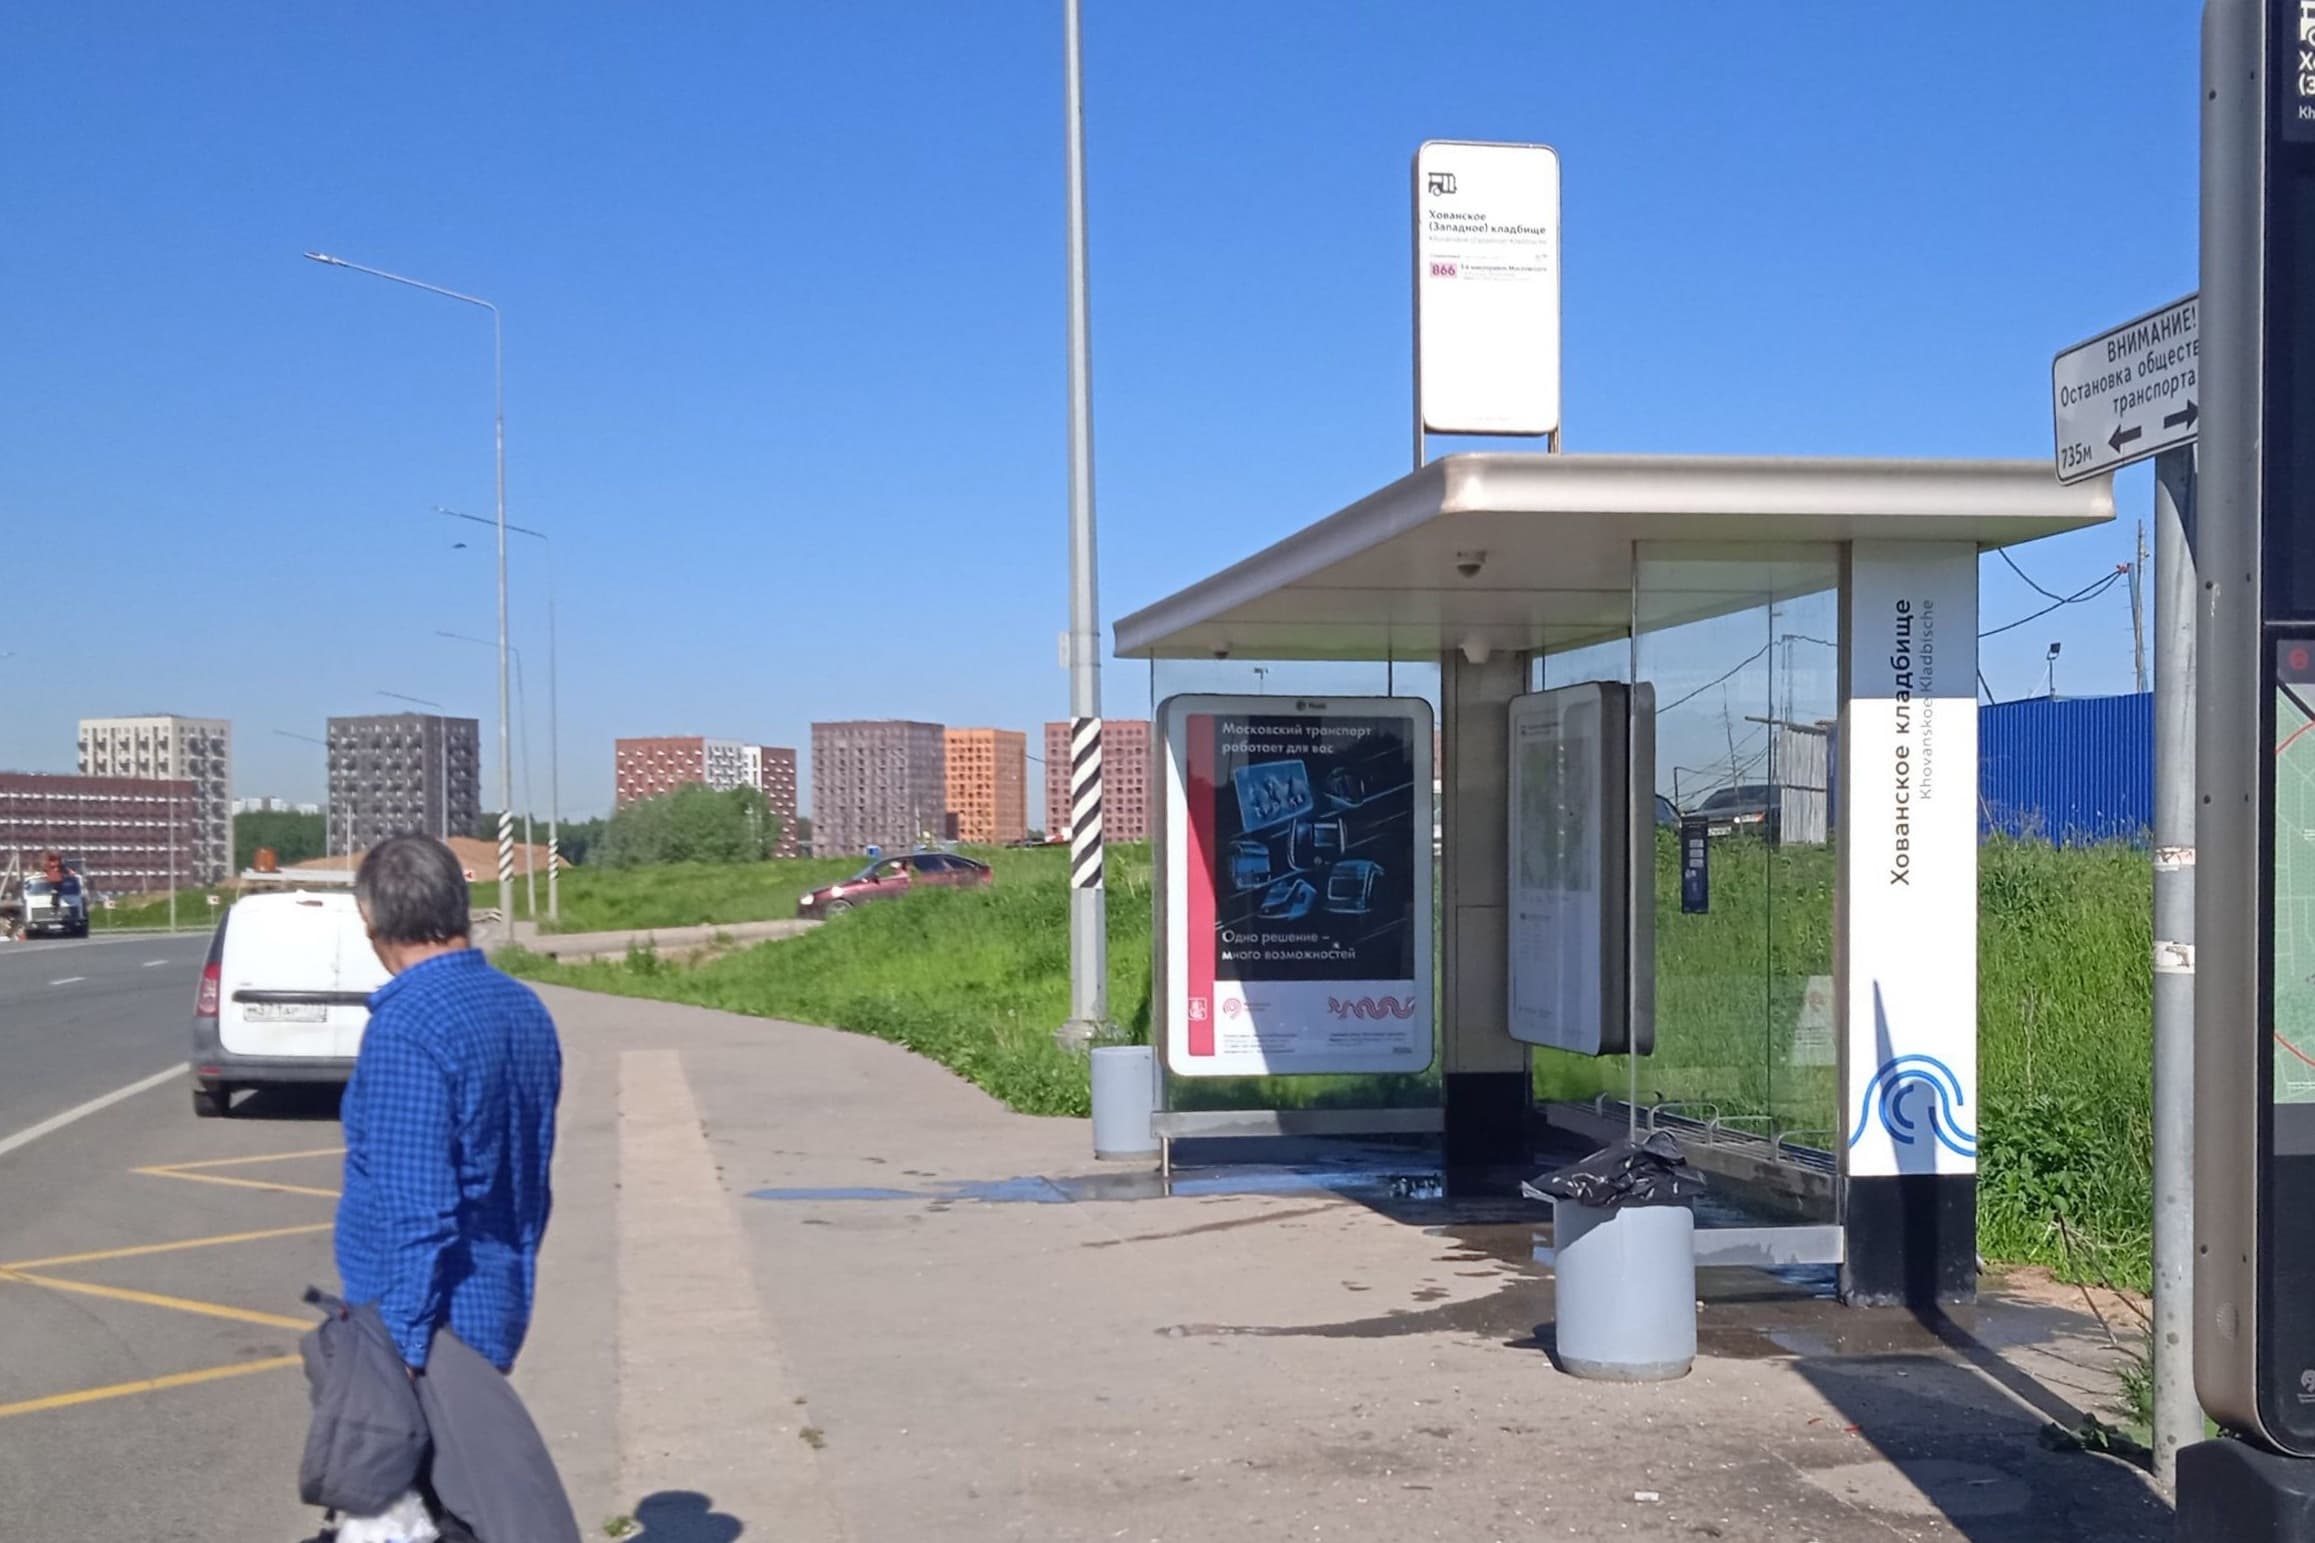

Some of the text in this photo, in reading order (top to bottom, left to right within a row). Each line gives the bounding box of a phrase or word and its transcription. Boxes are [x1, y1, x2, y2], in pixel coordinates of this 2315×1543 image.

[1428, 210, 1486, 221] Хованское
[1429, 221, 1546, 236] (Западное) кладбище
[1432, 264, 1456, 277] 866
[2107, 305, 2197, 363] ВНИМАНИЕ!
[2060, 367, 2132, 407] Остановка
[2113, 369, 2196, 418] транспорта
[2061, 442, 2093, 470] 735м
[1920, 599, 1933, 800] Khovanskoe Kladbische
[1222, 722, 1372, 740] Московский транспорт
[1222, 739, 1334, 755] работает для вас
[1890, 599, 1914, 886] Хованское кладбище
[1221, 930, 1258, 945] Одно
[1262, 932, 1318, 946] решение
[1221, 947, 1356, 960] много возможностей
